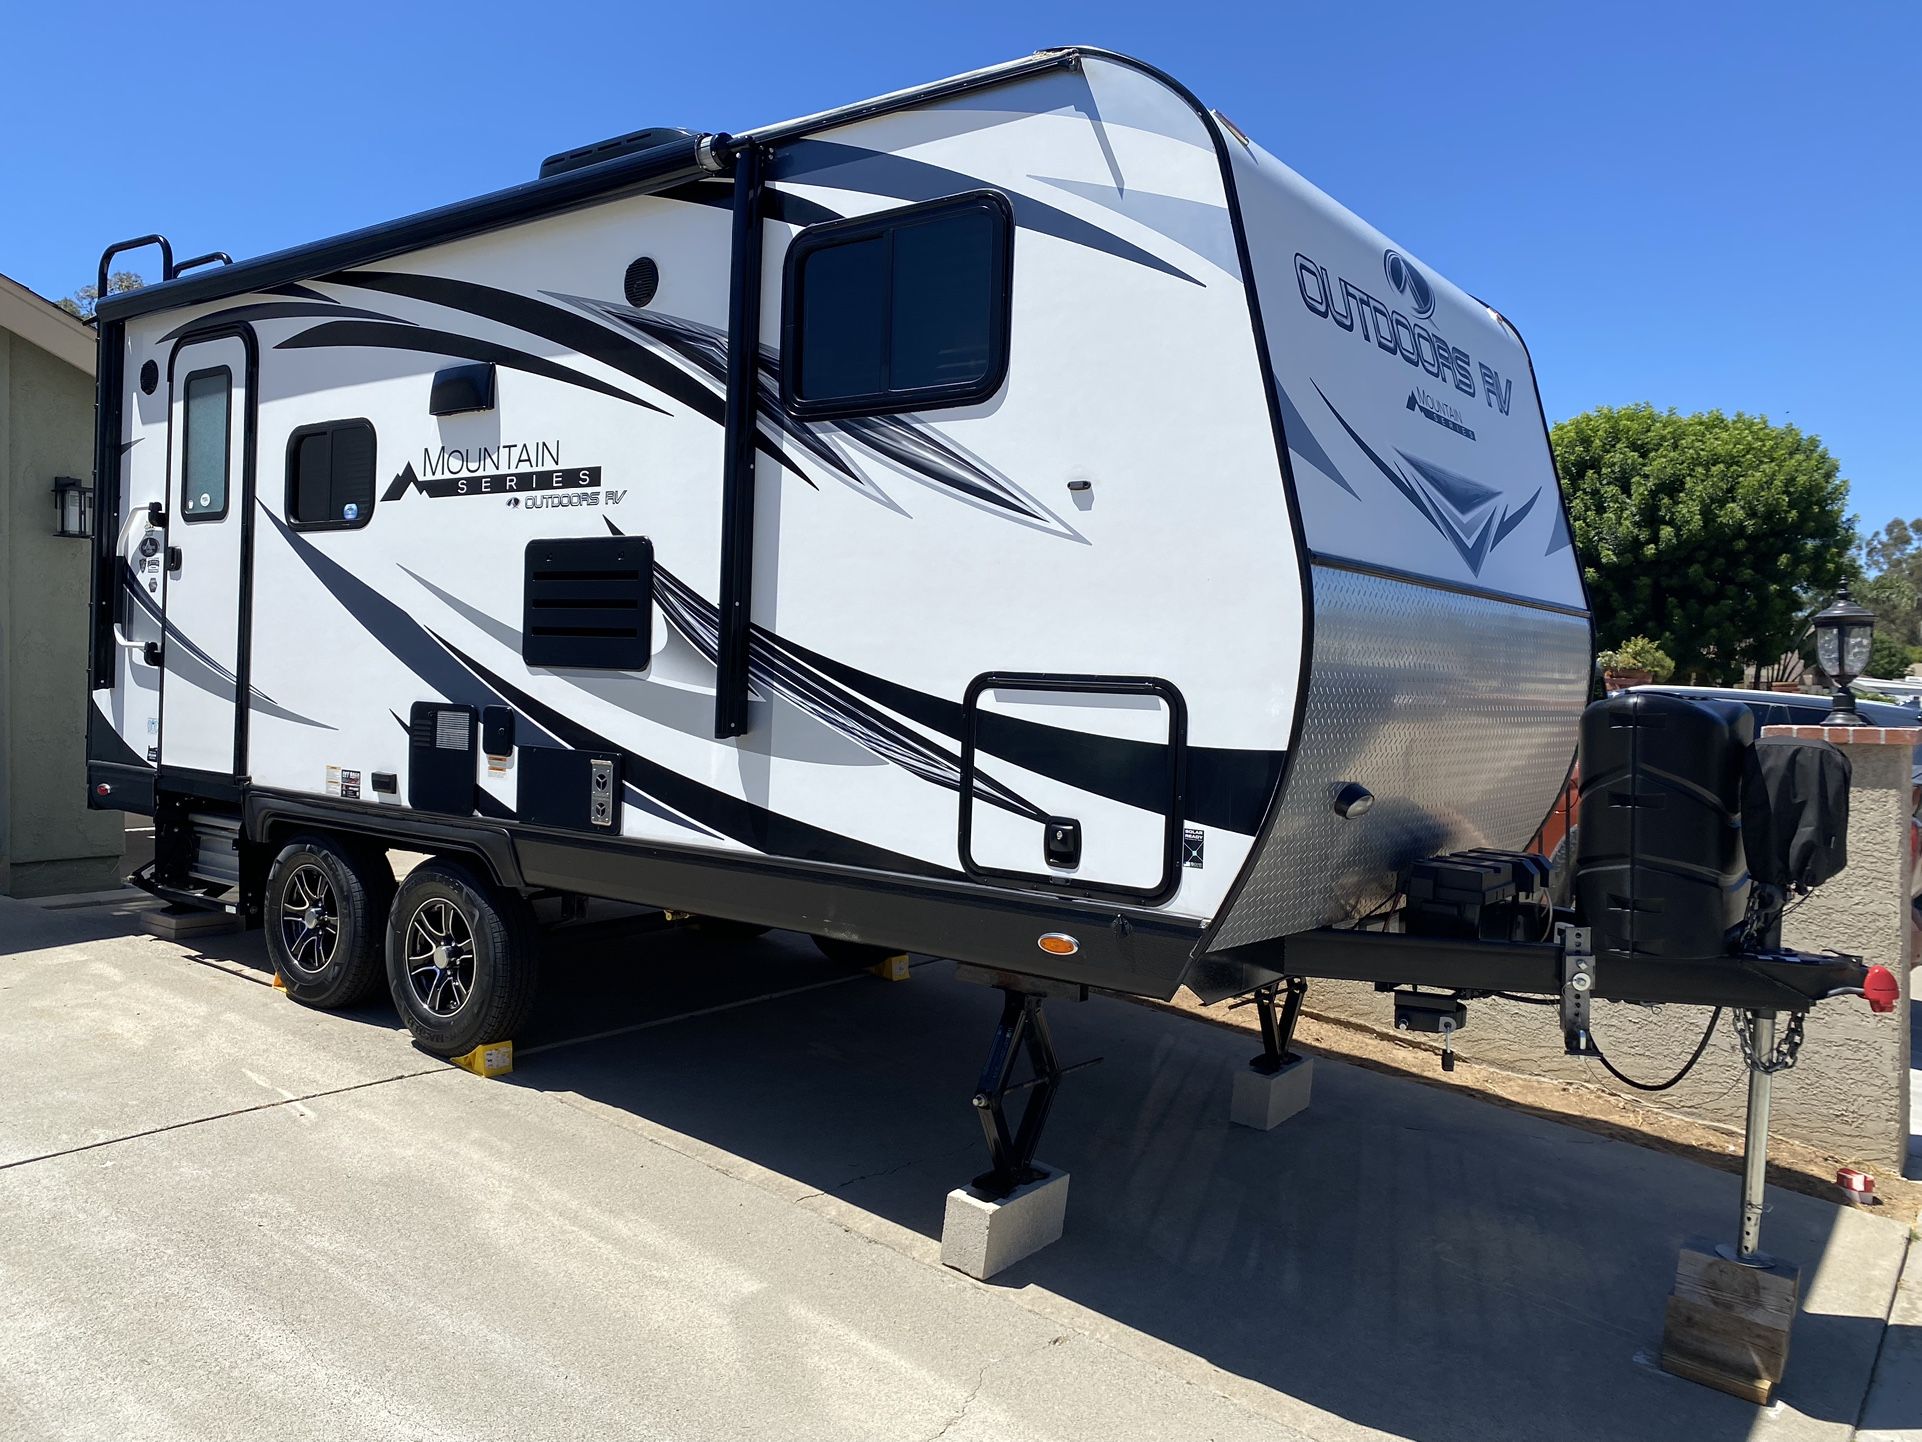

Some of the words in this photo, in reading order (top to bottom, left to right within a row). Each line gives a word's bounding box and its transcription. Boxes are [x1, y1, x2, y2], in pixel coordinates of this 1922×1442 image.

[1294, 252, 1476, 398] OUTDOORS
[1478, 361, 1512, 417] RV
[1416, 386, 1463, 424] MOUNTAIN
[1433, 413, 1474, 439] SERIES
[422, 440, 560, 477] MOUNTAIN
[457, 470, 591, 494] SERIES
[524, 491, 600, 510] OUTDOORS
[604, 489, 628, 506] RV
